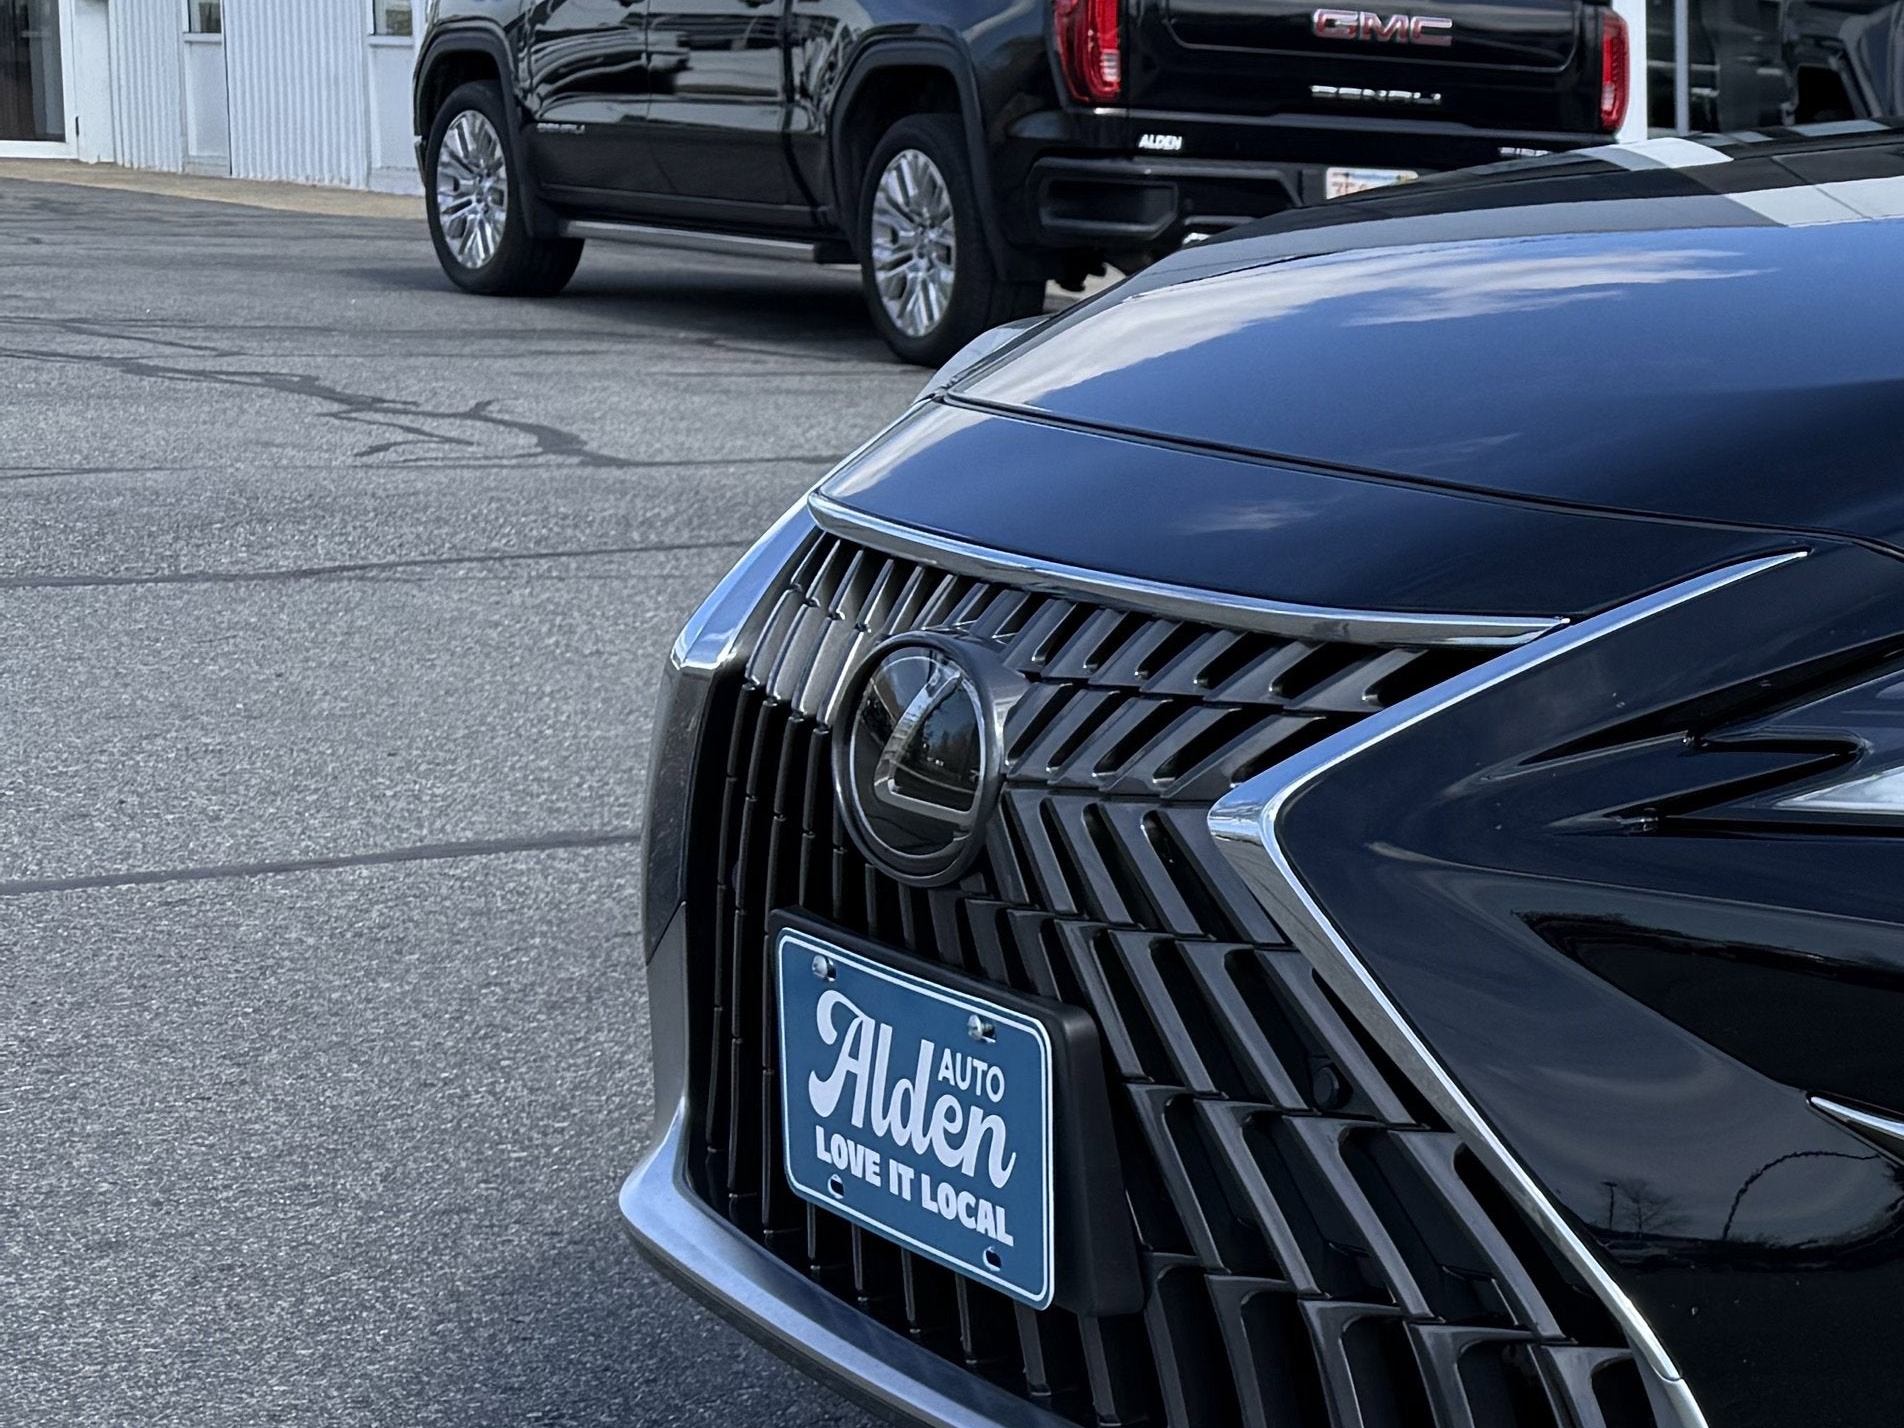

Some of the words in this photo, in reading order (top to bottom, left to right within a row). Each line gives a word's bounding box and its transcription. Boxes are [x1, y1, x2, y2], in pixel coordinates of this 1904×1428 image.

[1313, 8, 1453, 46] GMC
[1138, 133, 1183, 151] ALDEN
[807, 989, 1017, 1191] Alden
[938, 1048, 1005, 1104] AUTO
[816, 1125, 881, 1188] LOVE
[889, 1160, 914, 1201] IT
[921, 1174, 1014, 1247] LOCAL
